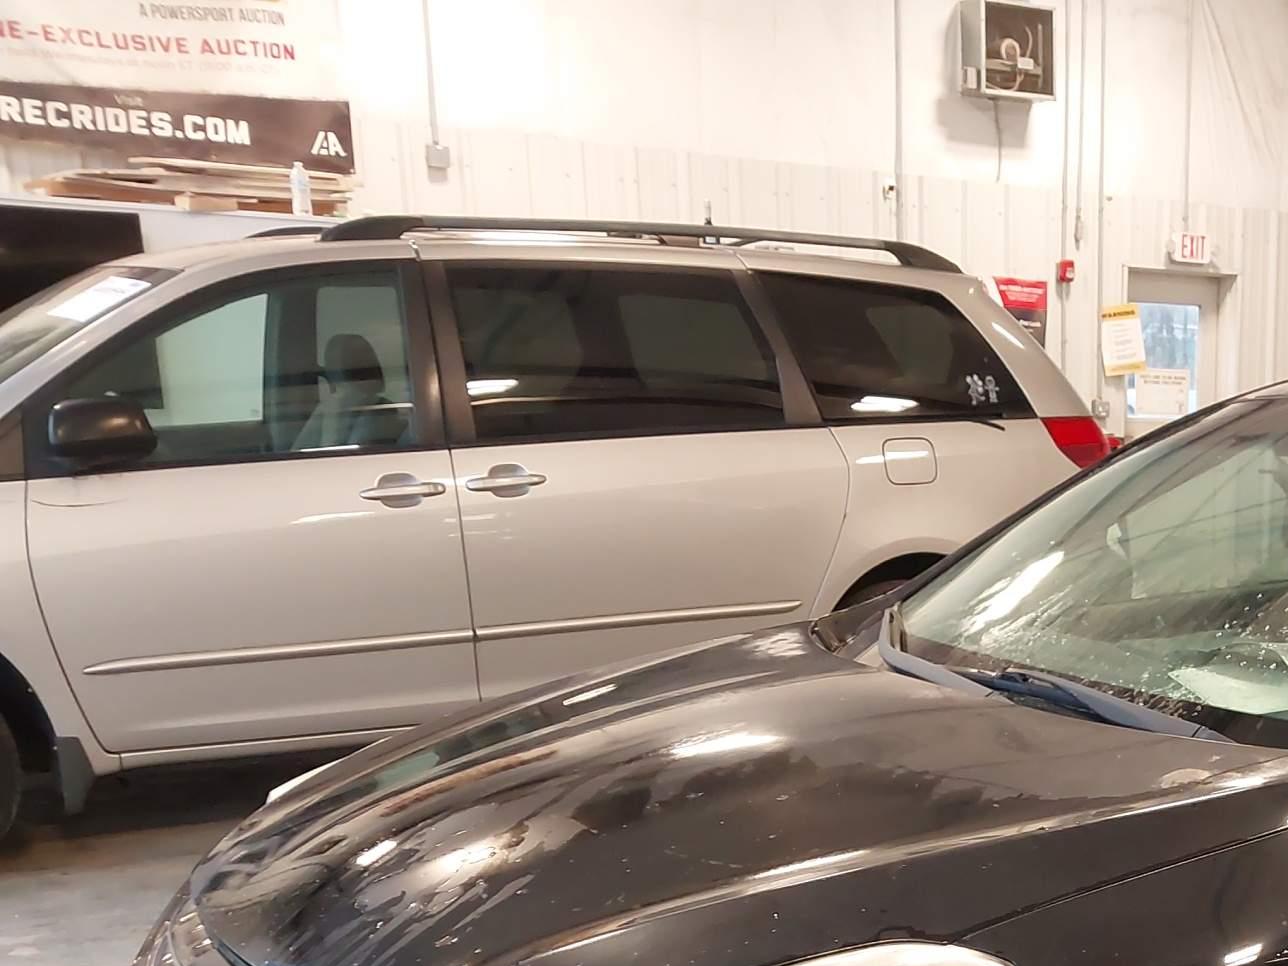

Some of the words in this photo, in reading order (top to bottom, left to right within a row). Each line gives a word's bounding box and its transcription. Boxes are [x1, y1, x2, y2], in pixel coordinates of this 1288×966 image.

[139, 3, 148, 18] A
[150, 4, 234, 22] POWERSPORT
[239, 8, 286, 26] AUCTION
[200, 38, 296, 60] AUCTION
[0, 94, 251, 146] RECRIDES.COM
[1181, 233, 1206, 260] EXIT
